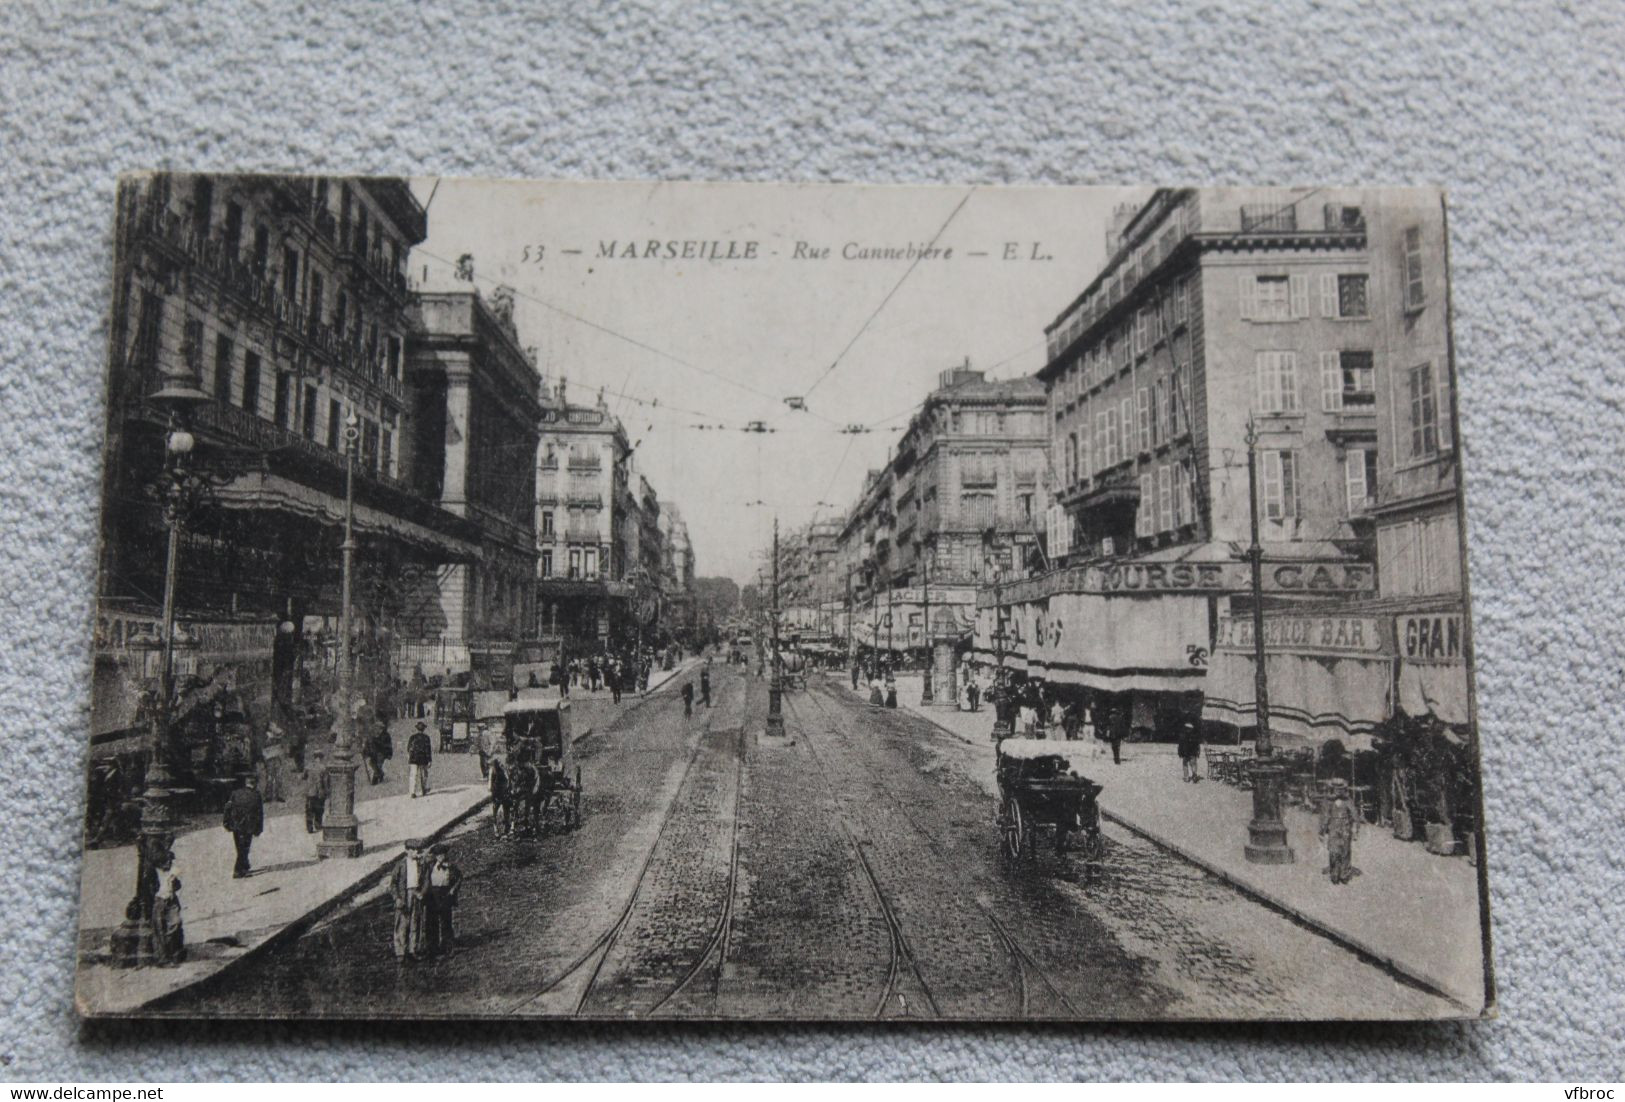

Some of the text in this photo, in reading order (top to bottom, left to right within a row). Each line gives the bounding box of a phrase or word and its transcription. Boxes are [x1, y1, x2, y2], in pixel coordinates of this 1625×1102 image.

[521, 245, 545, 262] 53
[595, 240, 760, 259] MARSEILLE
[791, 241, 831, 260] Rue
[1003, 242, 1018, 260] E
[273, 292, 307, 336] VENTE
[1321, 619, 1366, 646] BAR
[1406, 617, 1460, 657] GRAN
